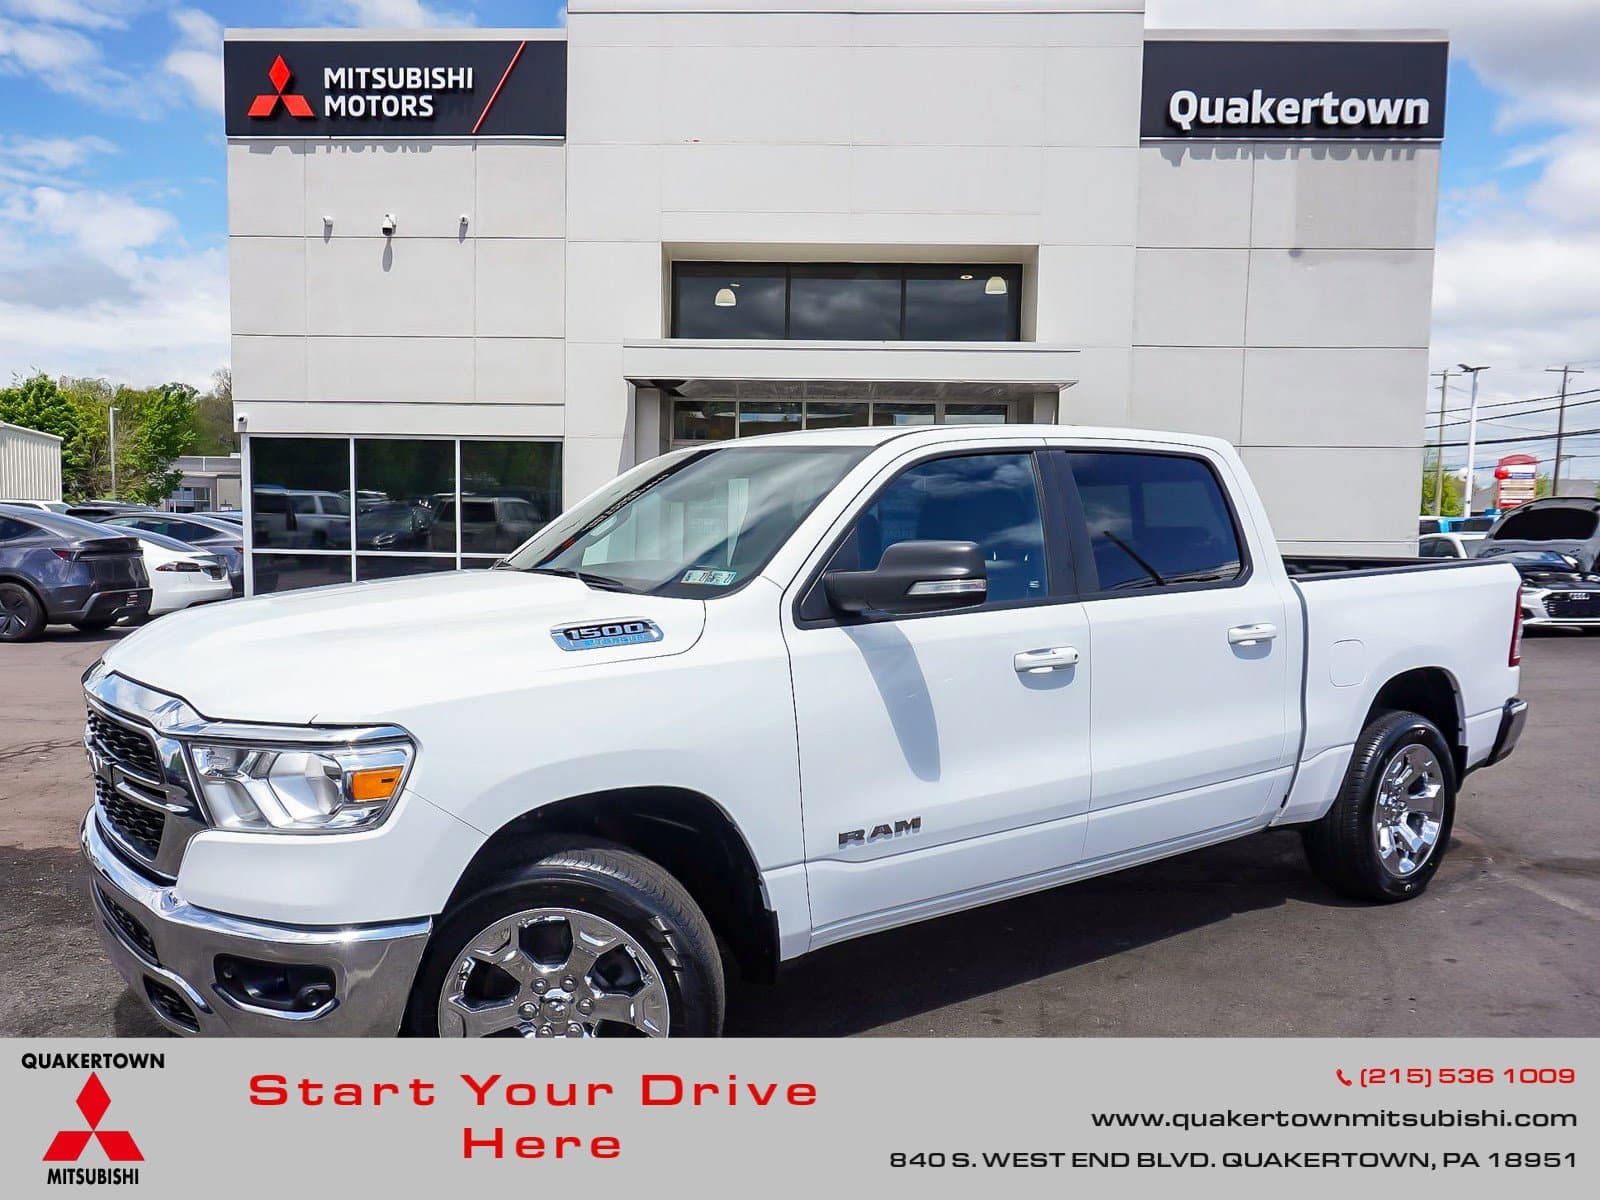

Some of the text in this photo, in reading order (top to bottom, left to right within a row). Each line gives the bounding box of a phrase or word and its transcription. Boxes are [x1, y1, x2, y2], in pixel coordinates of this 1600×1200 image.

[323, 66, 474, 90] MITSUBISHI
[323, 93, 435, 118] MOTORS
[1169, 89, 1430, 132] Quakertown
[567, 622, 645, 640] 1500
[838, 816, 922, 846] RAM
